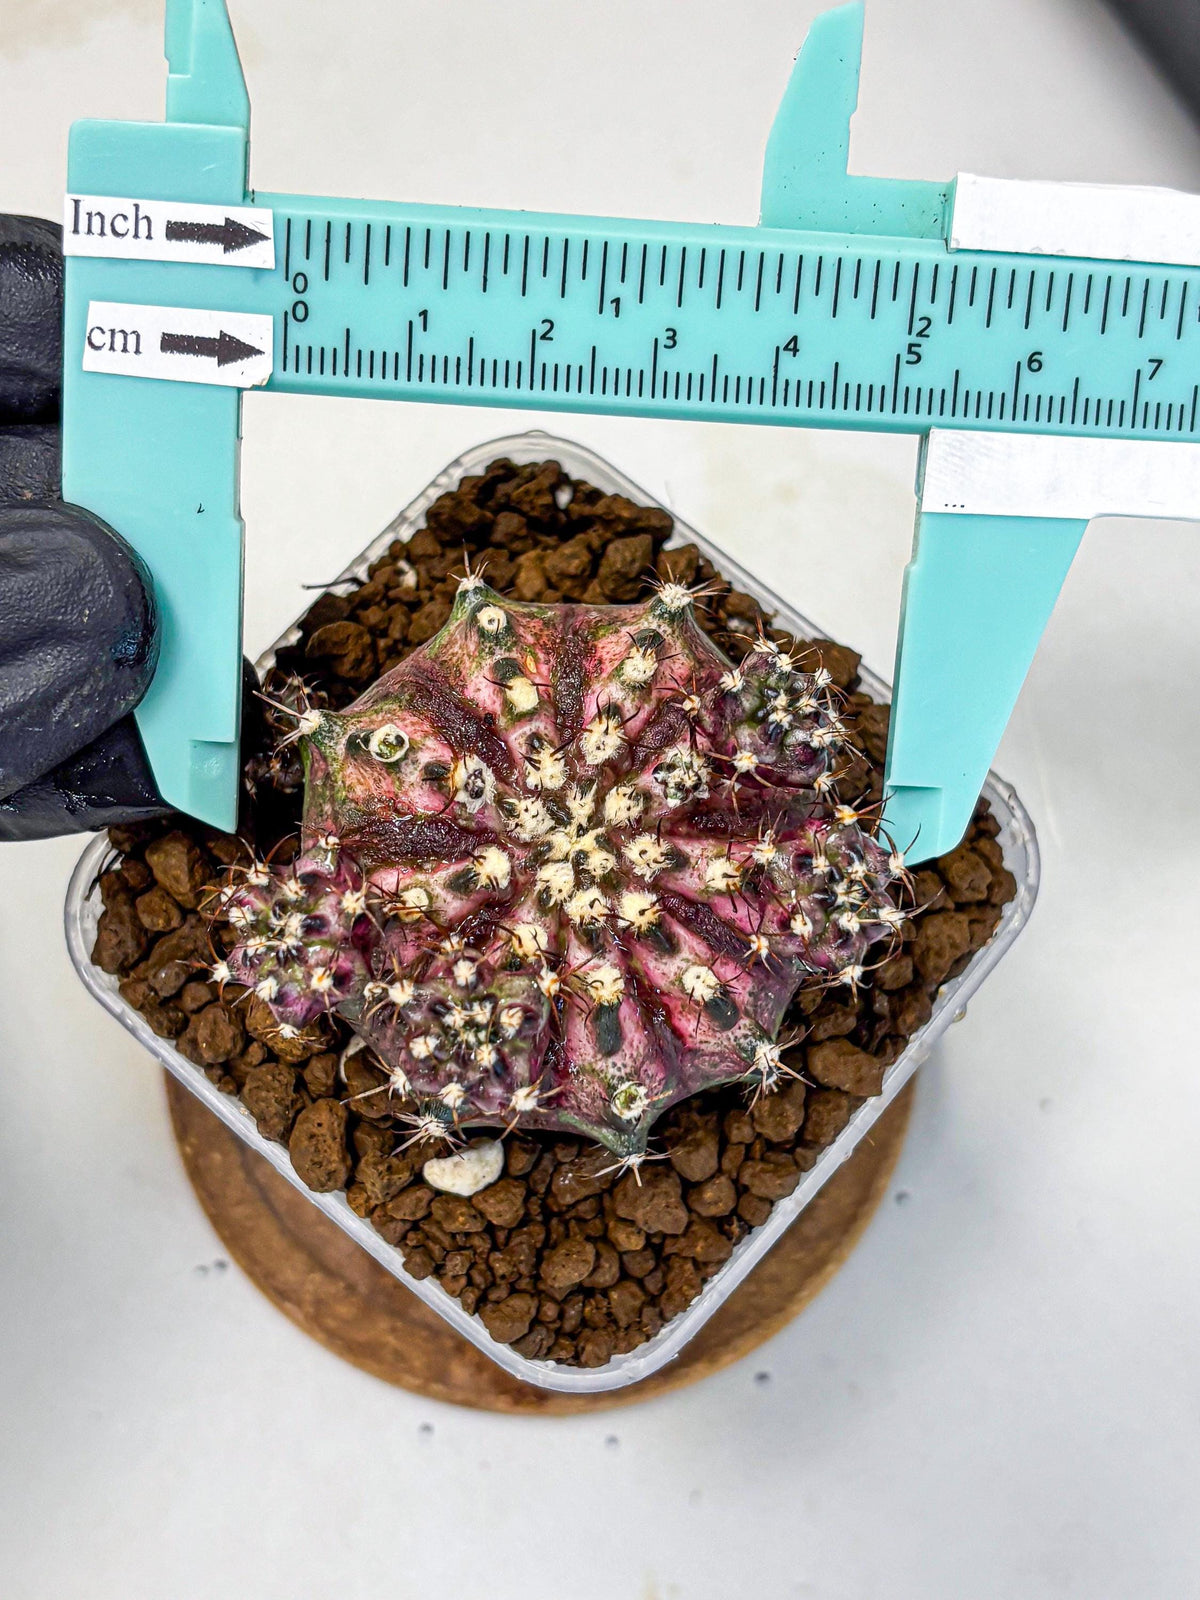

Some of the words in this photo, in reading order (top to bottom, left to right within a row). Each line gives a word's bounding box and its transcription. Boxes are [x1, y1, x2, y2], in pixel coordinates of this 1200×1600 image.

[69, 199, 154, 240] Inch
[292, 272, 308, 294] 0
[610, 297, 621, 318] 1
[915, 317, 932, 338] 2
[87, 326, 142, 355] cm
[292, 300, 309, 322] 0
[418, 309, 429, 332] 1
[539, 319, 555, 341] 2
[663, 328, 678, 349] 3
[783, 335, 800, 357] 4
[905, 344, 922, 365] 5
[1027, 352, 1043, 373] 6
[1148, 359, 1163, 380] 7
